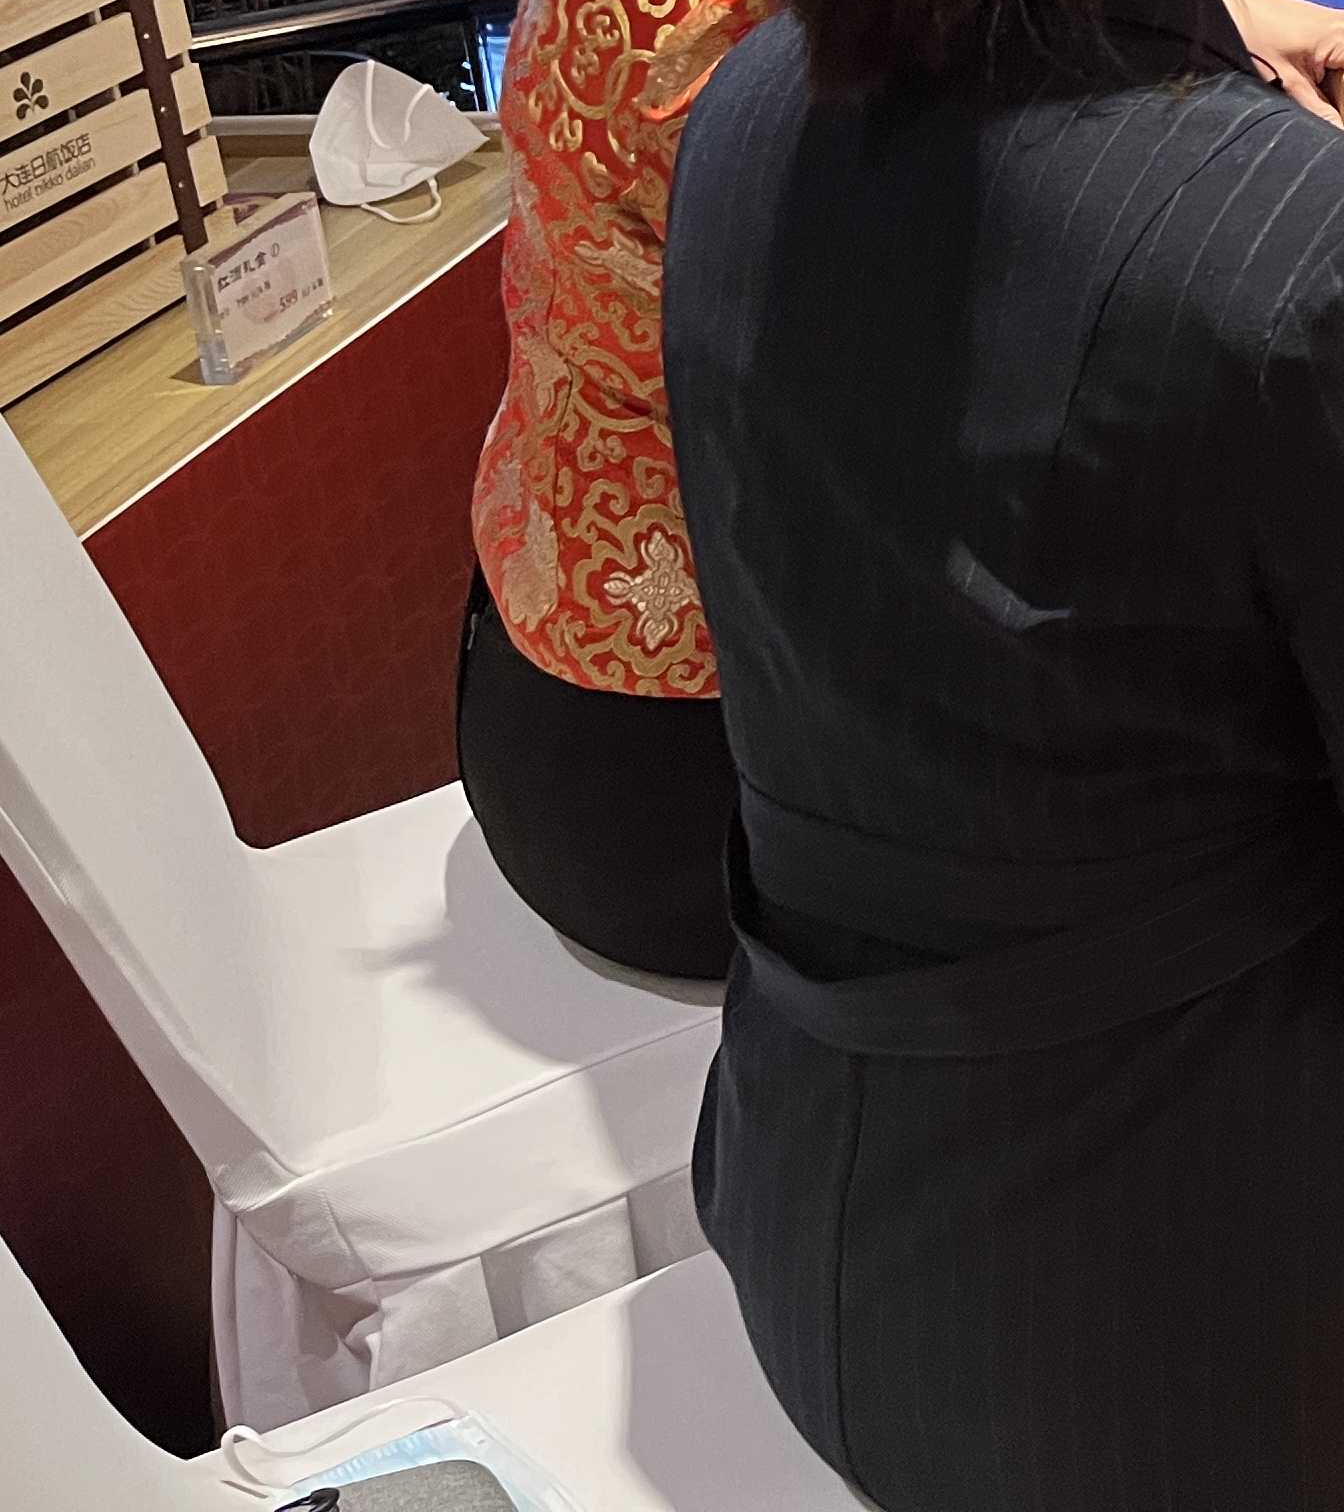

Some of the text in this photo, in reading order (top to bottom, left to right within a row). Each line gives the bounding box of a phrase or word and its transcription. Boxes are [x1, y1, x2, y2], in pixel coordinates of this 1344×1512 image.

[0, 133, 92, 195] 大连日航饭店
